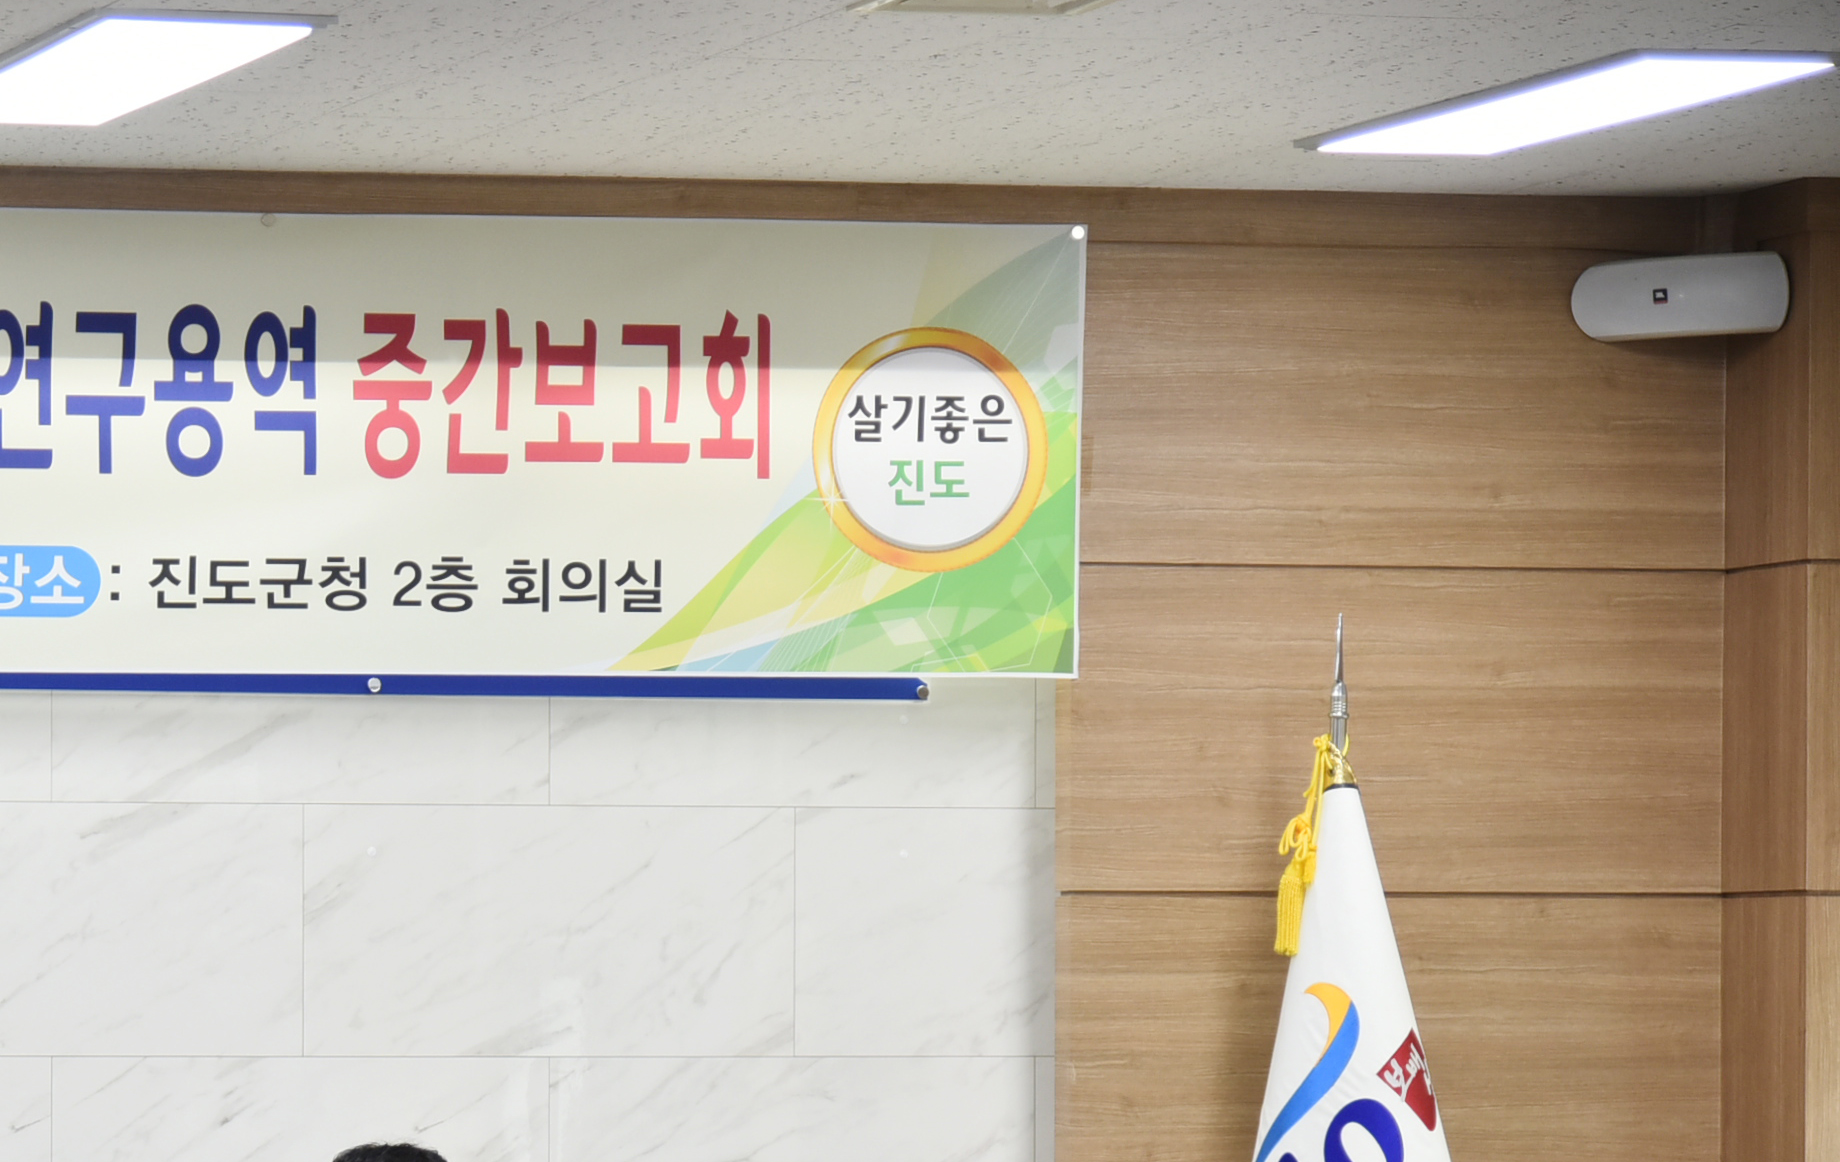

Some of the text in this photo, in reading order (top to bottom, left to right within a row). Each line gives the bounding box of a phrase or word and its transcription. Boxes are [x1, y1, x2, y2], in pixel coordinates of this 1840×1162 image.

[352, 308, 773, 480] 중간보고회
[847, 394, 1013, 445] 살기좋은
[888, 458, 971, 507] 진도
[148, 556, 368, 611] 진도군청
[393, 557, 478, 613] 2층
[502, 558, 664, 613] 회의실
